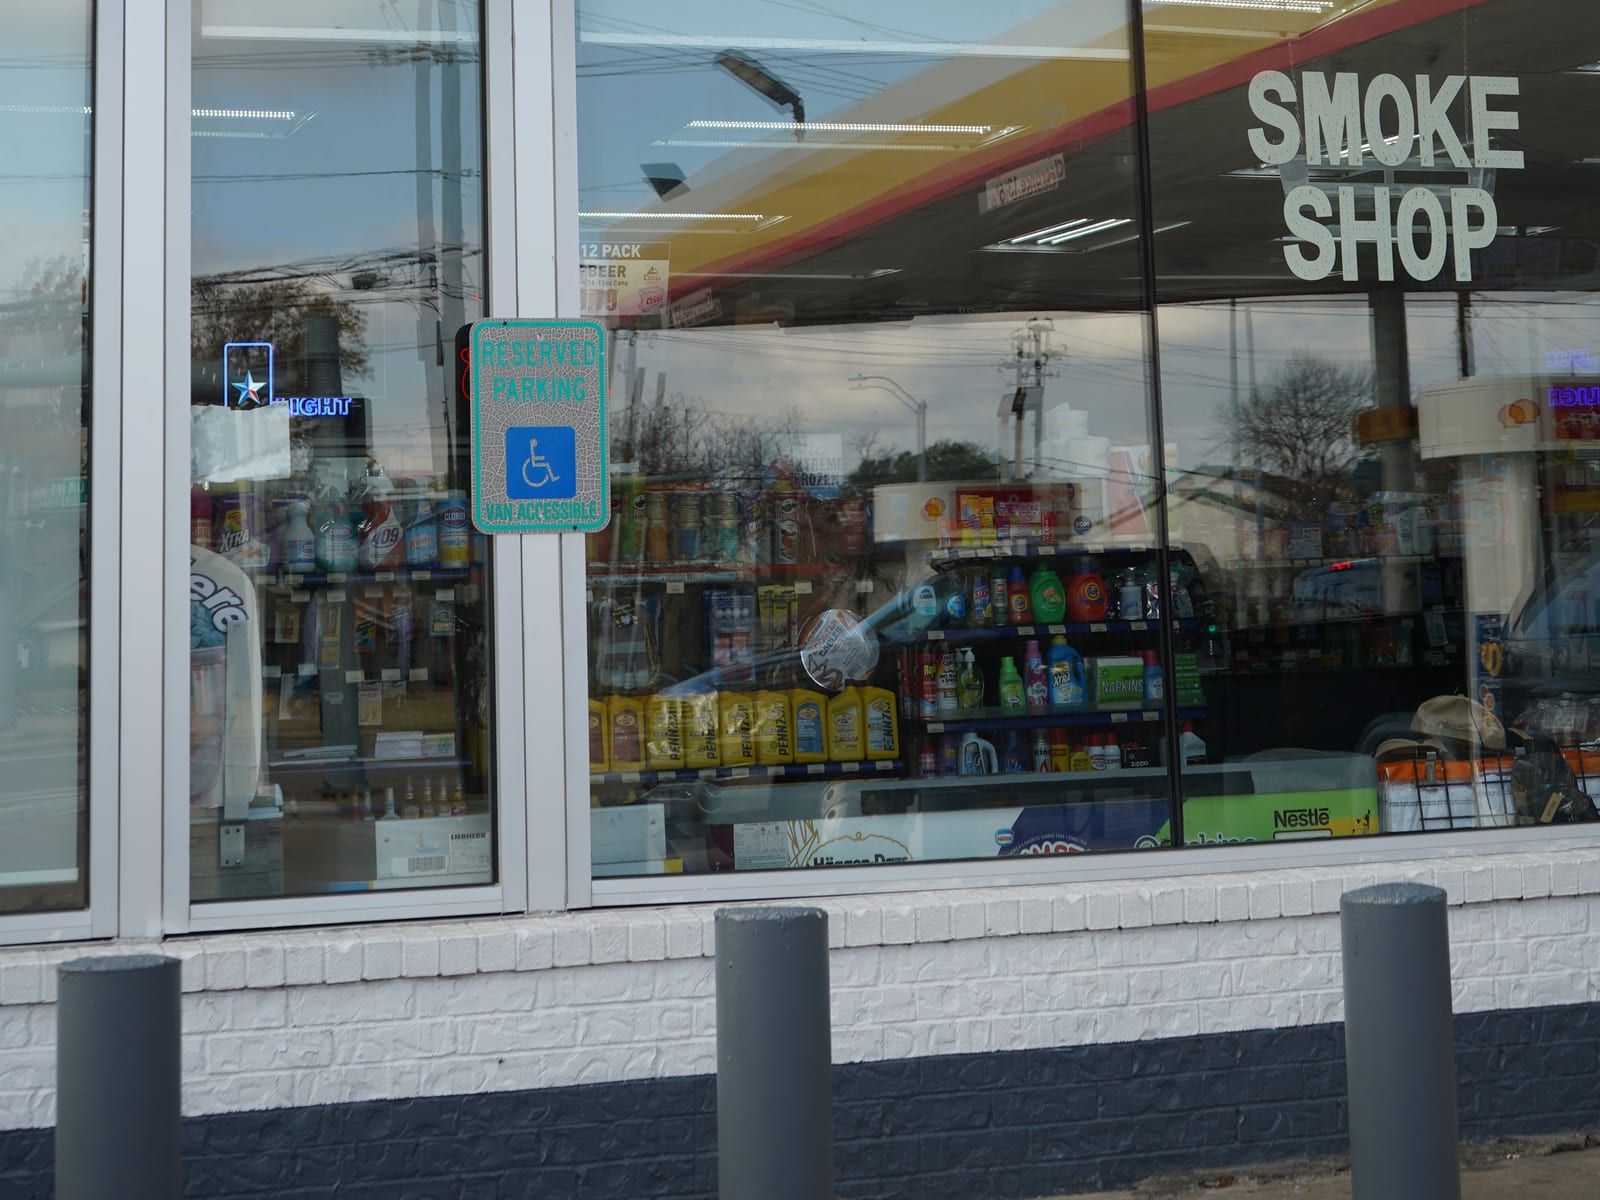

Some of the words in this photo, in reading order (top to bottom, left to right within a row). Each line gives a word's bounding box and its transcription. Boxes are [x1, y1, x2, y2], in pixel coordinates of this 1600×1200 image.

[1247, 70, 1525, 169] SMOKE
[1282, 185, 1498, 282] SHOP
[580, 244, 598, 258] 12
[602, 244, 642, 258] PACK
[482, 340, 597, 367] RESERVED
[493, 376, 586, 403] PARKING
[277, 397, 352, 416] IGHT
[486, 503, 514, 521] VAN
[517, 500, 598, 521] ACCESSIBLE
[371, 527, 399, 545] 409
[190, 573, 249, 635] ere
[1102, 678, 1144, 695] NAPKINS
